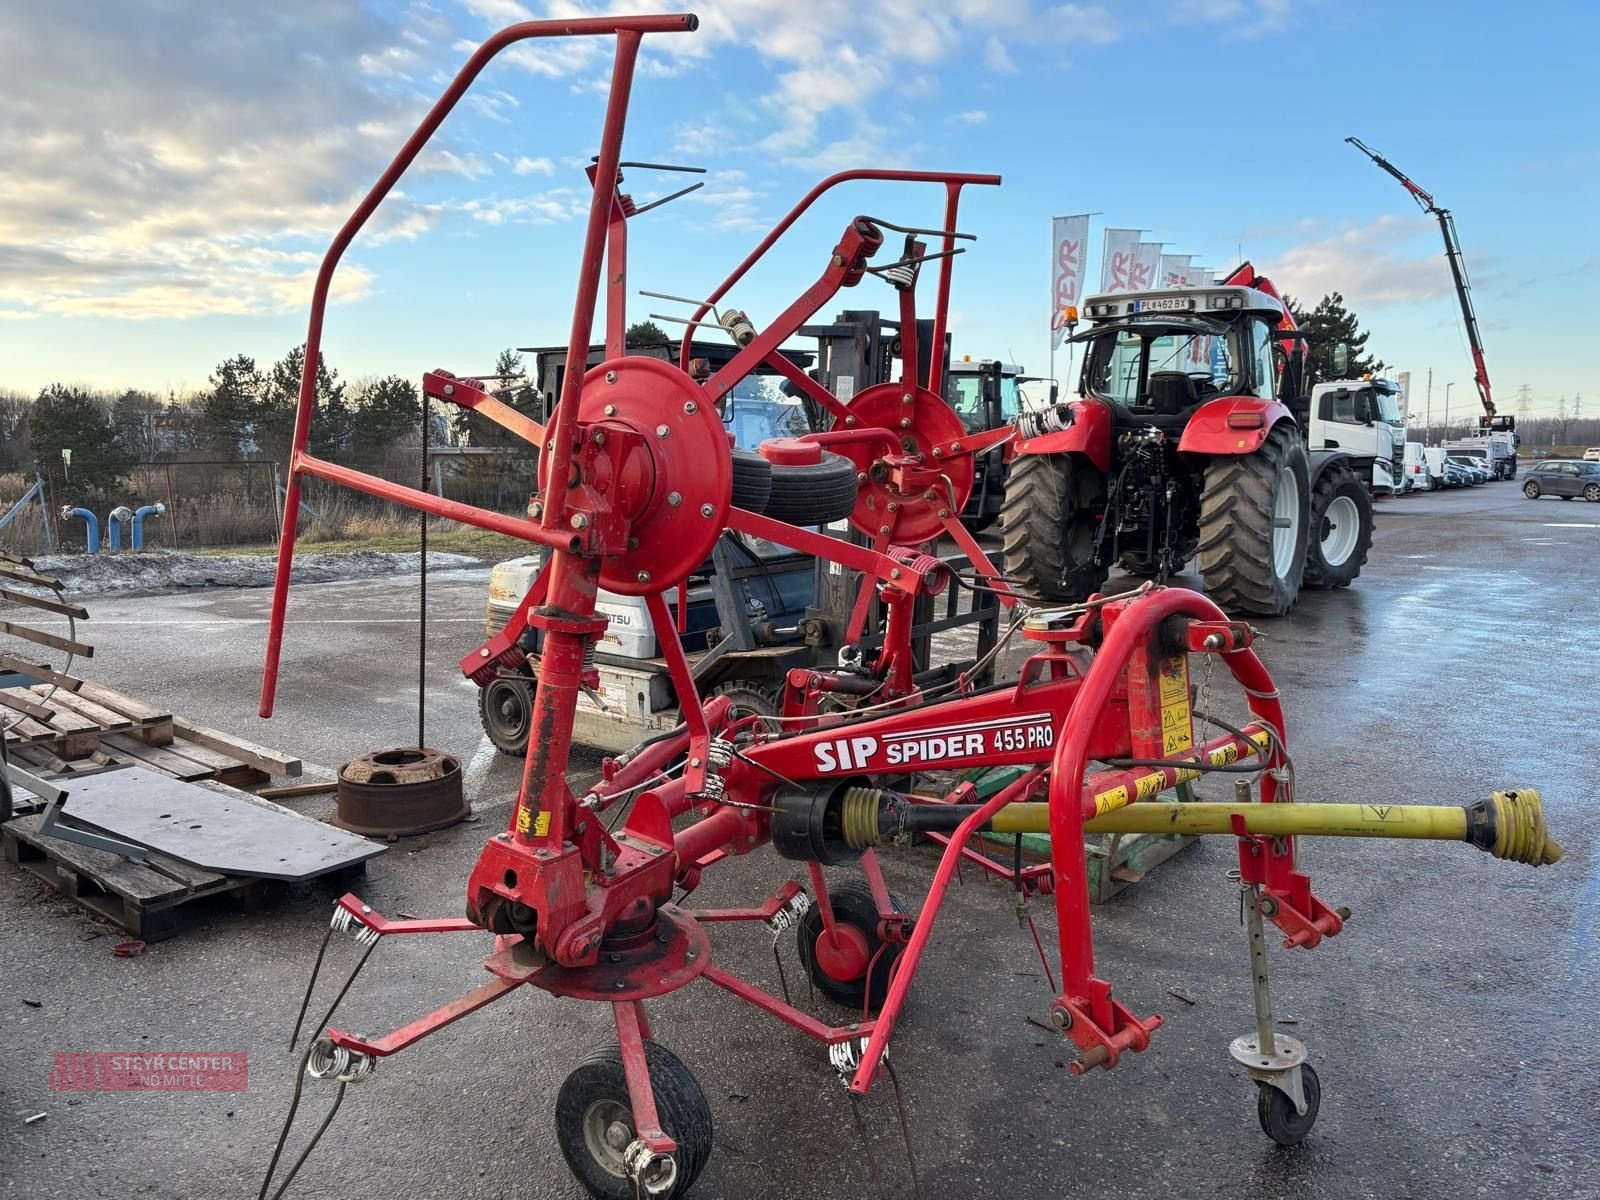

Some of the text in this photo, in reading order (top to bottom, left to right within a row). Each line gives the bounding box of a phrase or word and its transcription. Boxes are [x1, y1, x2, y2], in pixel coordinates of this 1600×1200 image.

[1141, 301, 1151, 311] PL
[814, 725, 1053, 773] SIP SPIDER 455 PRO
